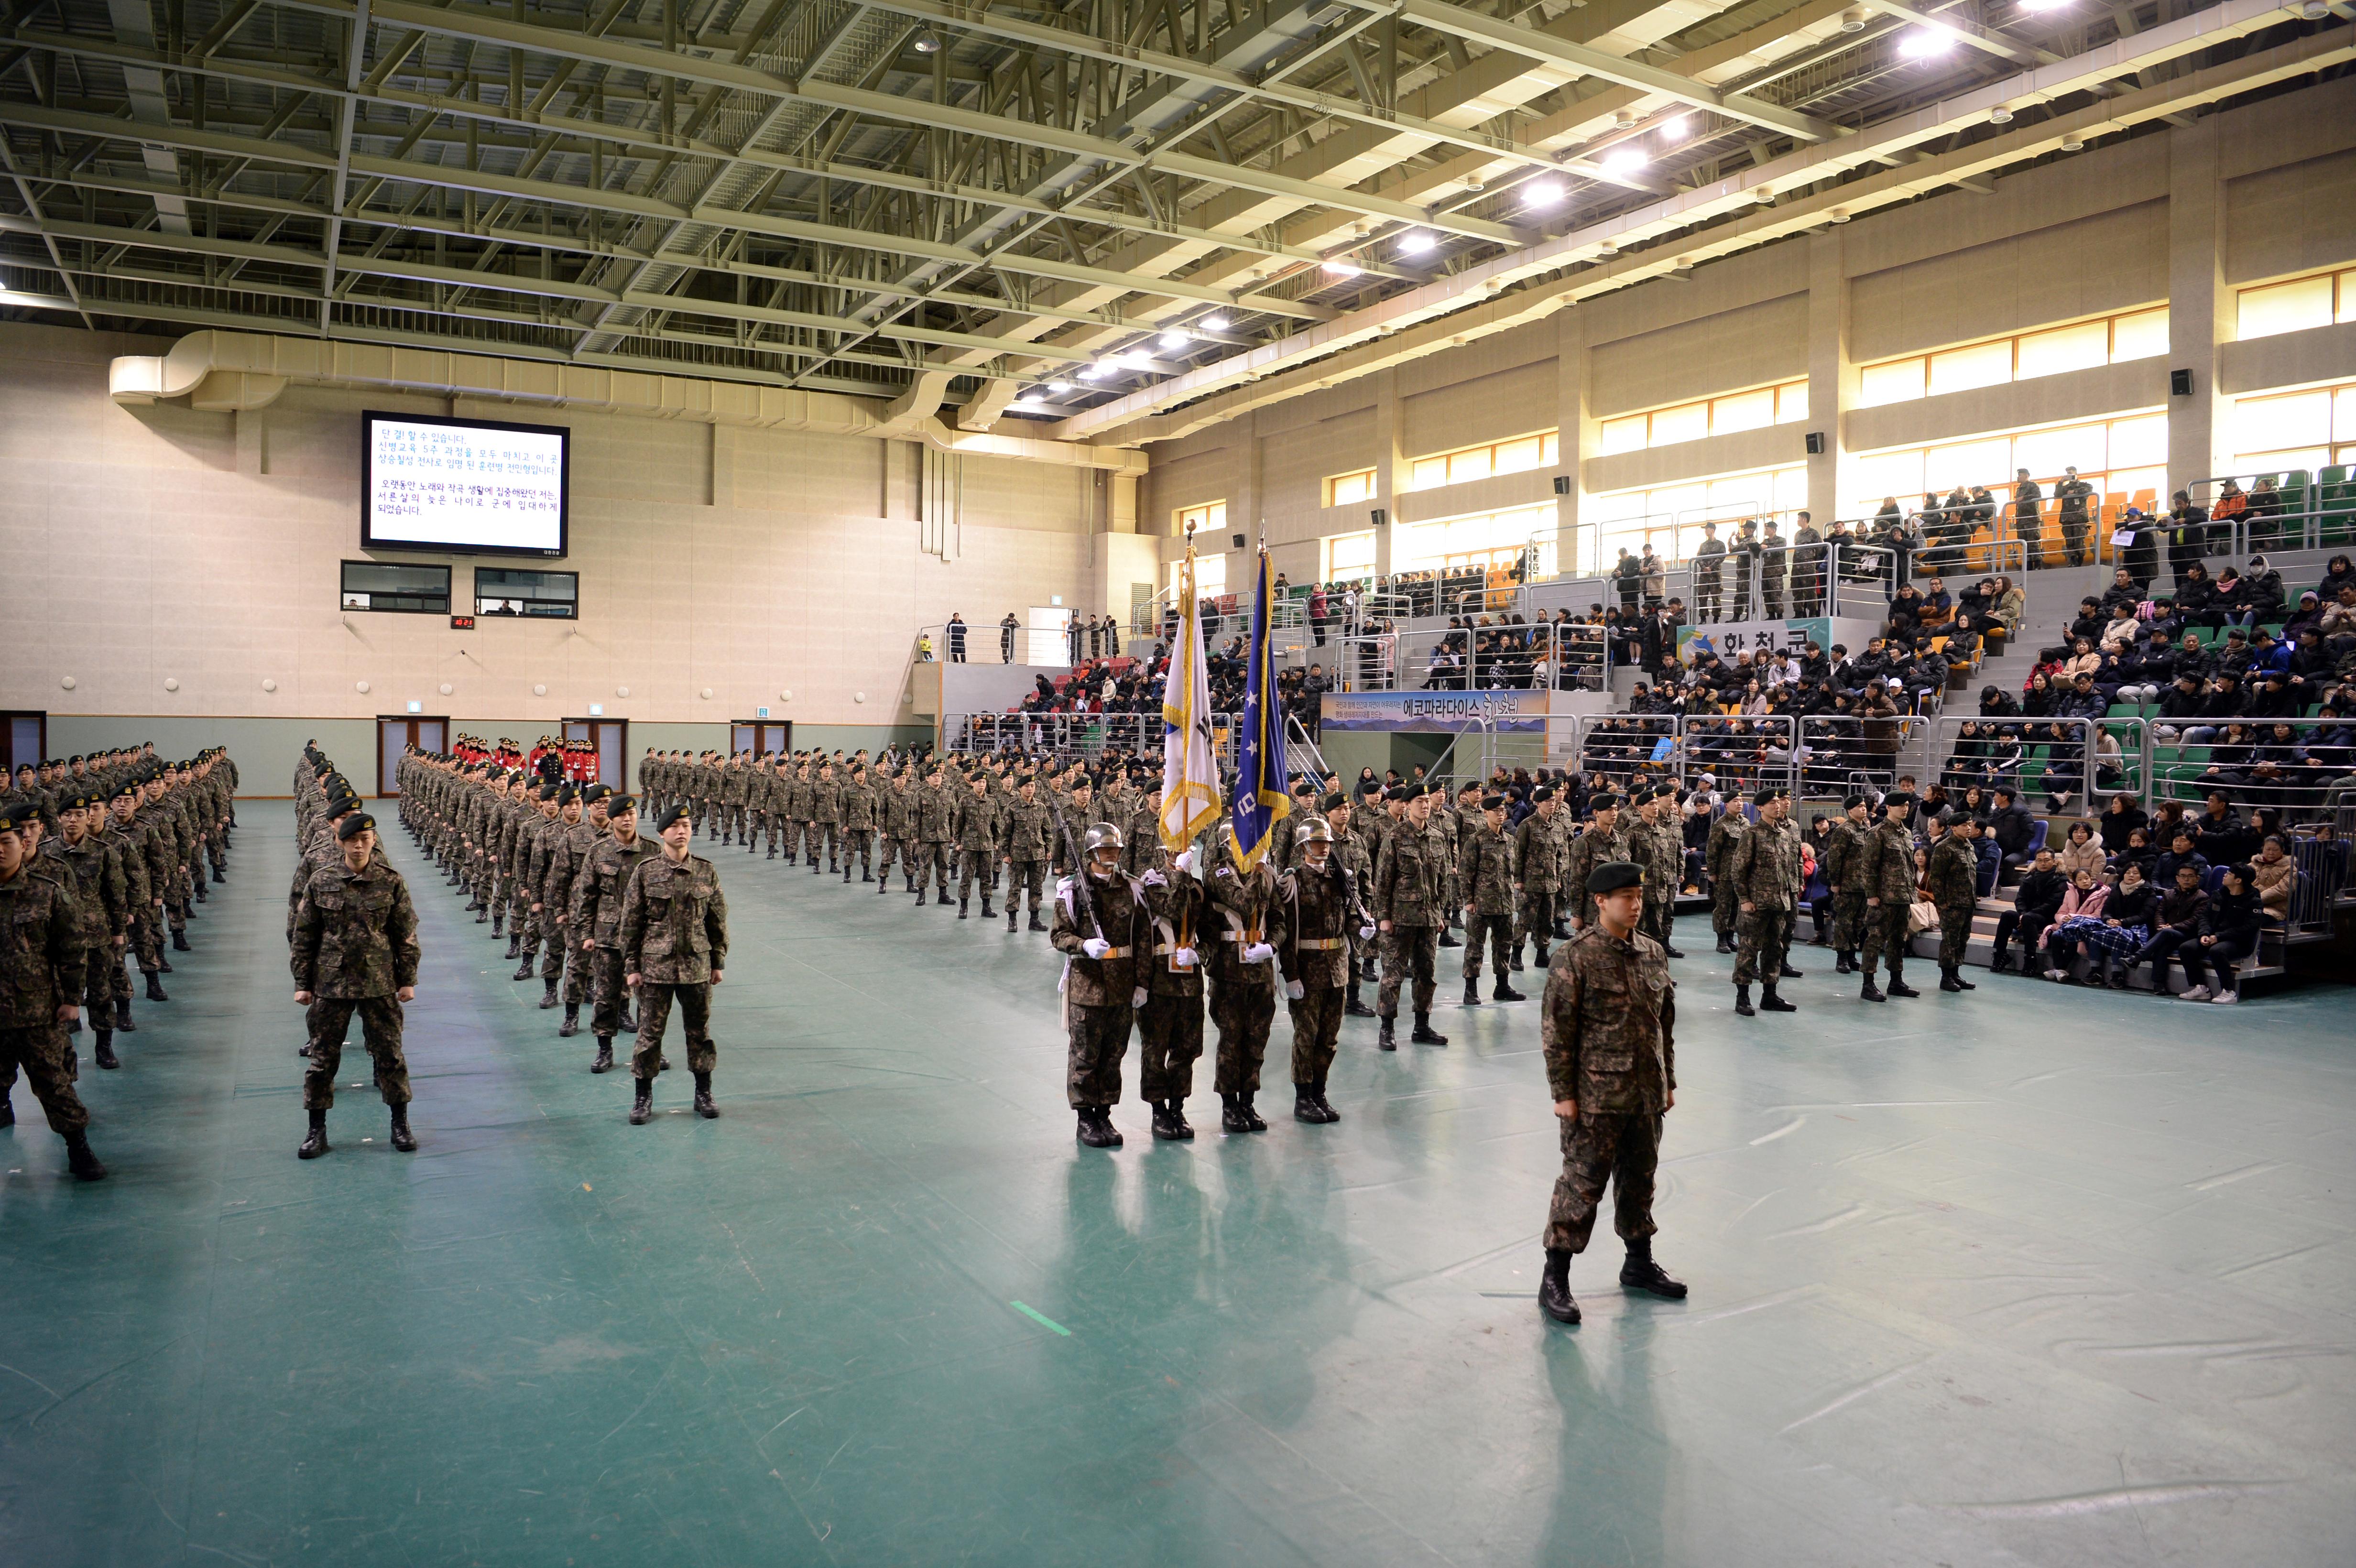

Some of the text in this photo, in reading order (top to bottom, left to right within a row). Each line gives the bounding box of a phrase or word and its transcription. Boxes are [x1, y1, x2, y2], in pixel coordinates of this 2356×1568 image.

[408, 431, 416, 441] 할
[420, 432, 427, 441] 수
[431, 433, 467, 445] 있습니다.
[379, 441, 417, 454] 신병교육
[424, 445, 438, 455] 5주
[445, 446, 472, 457] 과정을
[479, 449, 496, 459] 모두
[503, 451, 530, 461] 마치고
[379, 454, 557, 476] 상승칠성 전사로 임명 된 훈련병 전민형입니다.
[382, 479, 556, 500] 오랫동안 노래와 작곡 생활에 집중해왔던 저는,
[378, 491, 557, 512] 서른살의 늦은 나이로 군에 입대하게
[378, 504, 422, 516] 되었습니다.
[1403, 692, 1518, 725] 에코파라다이스 화천
